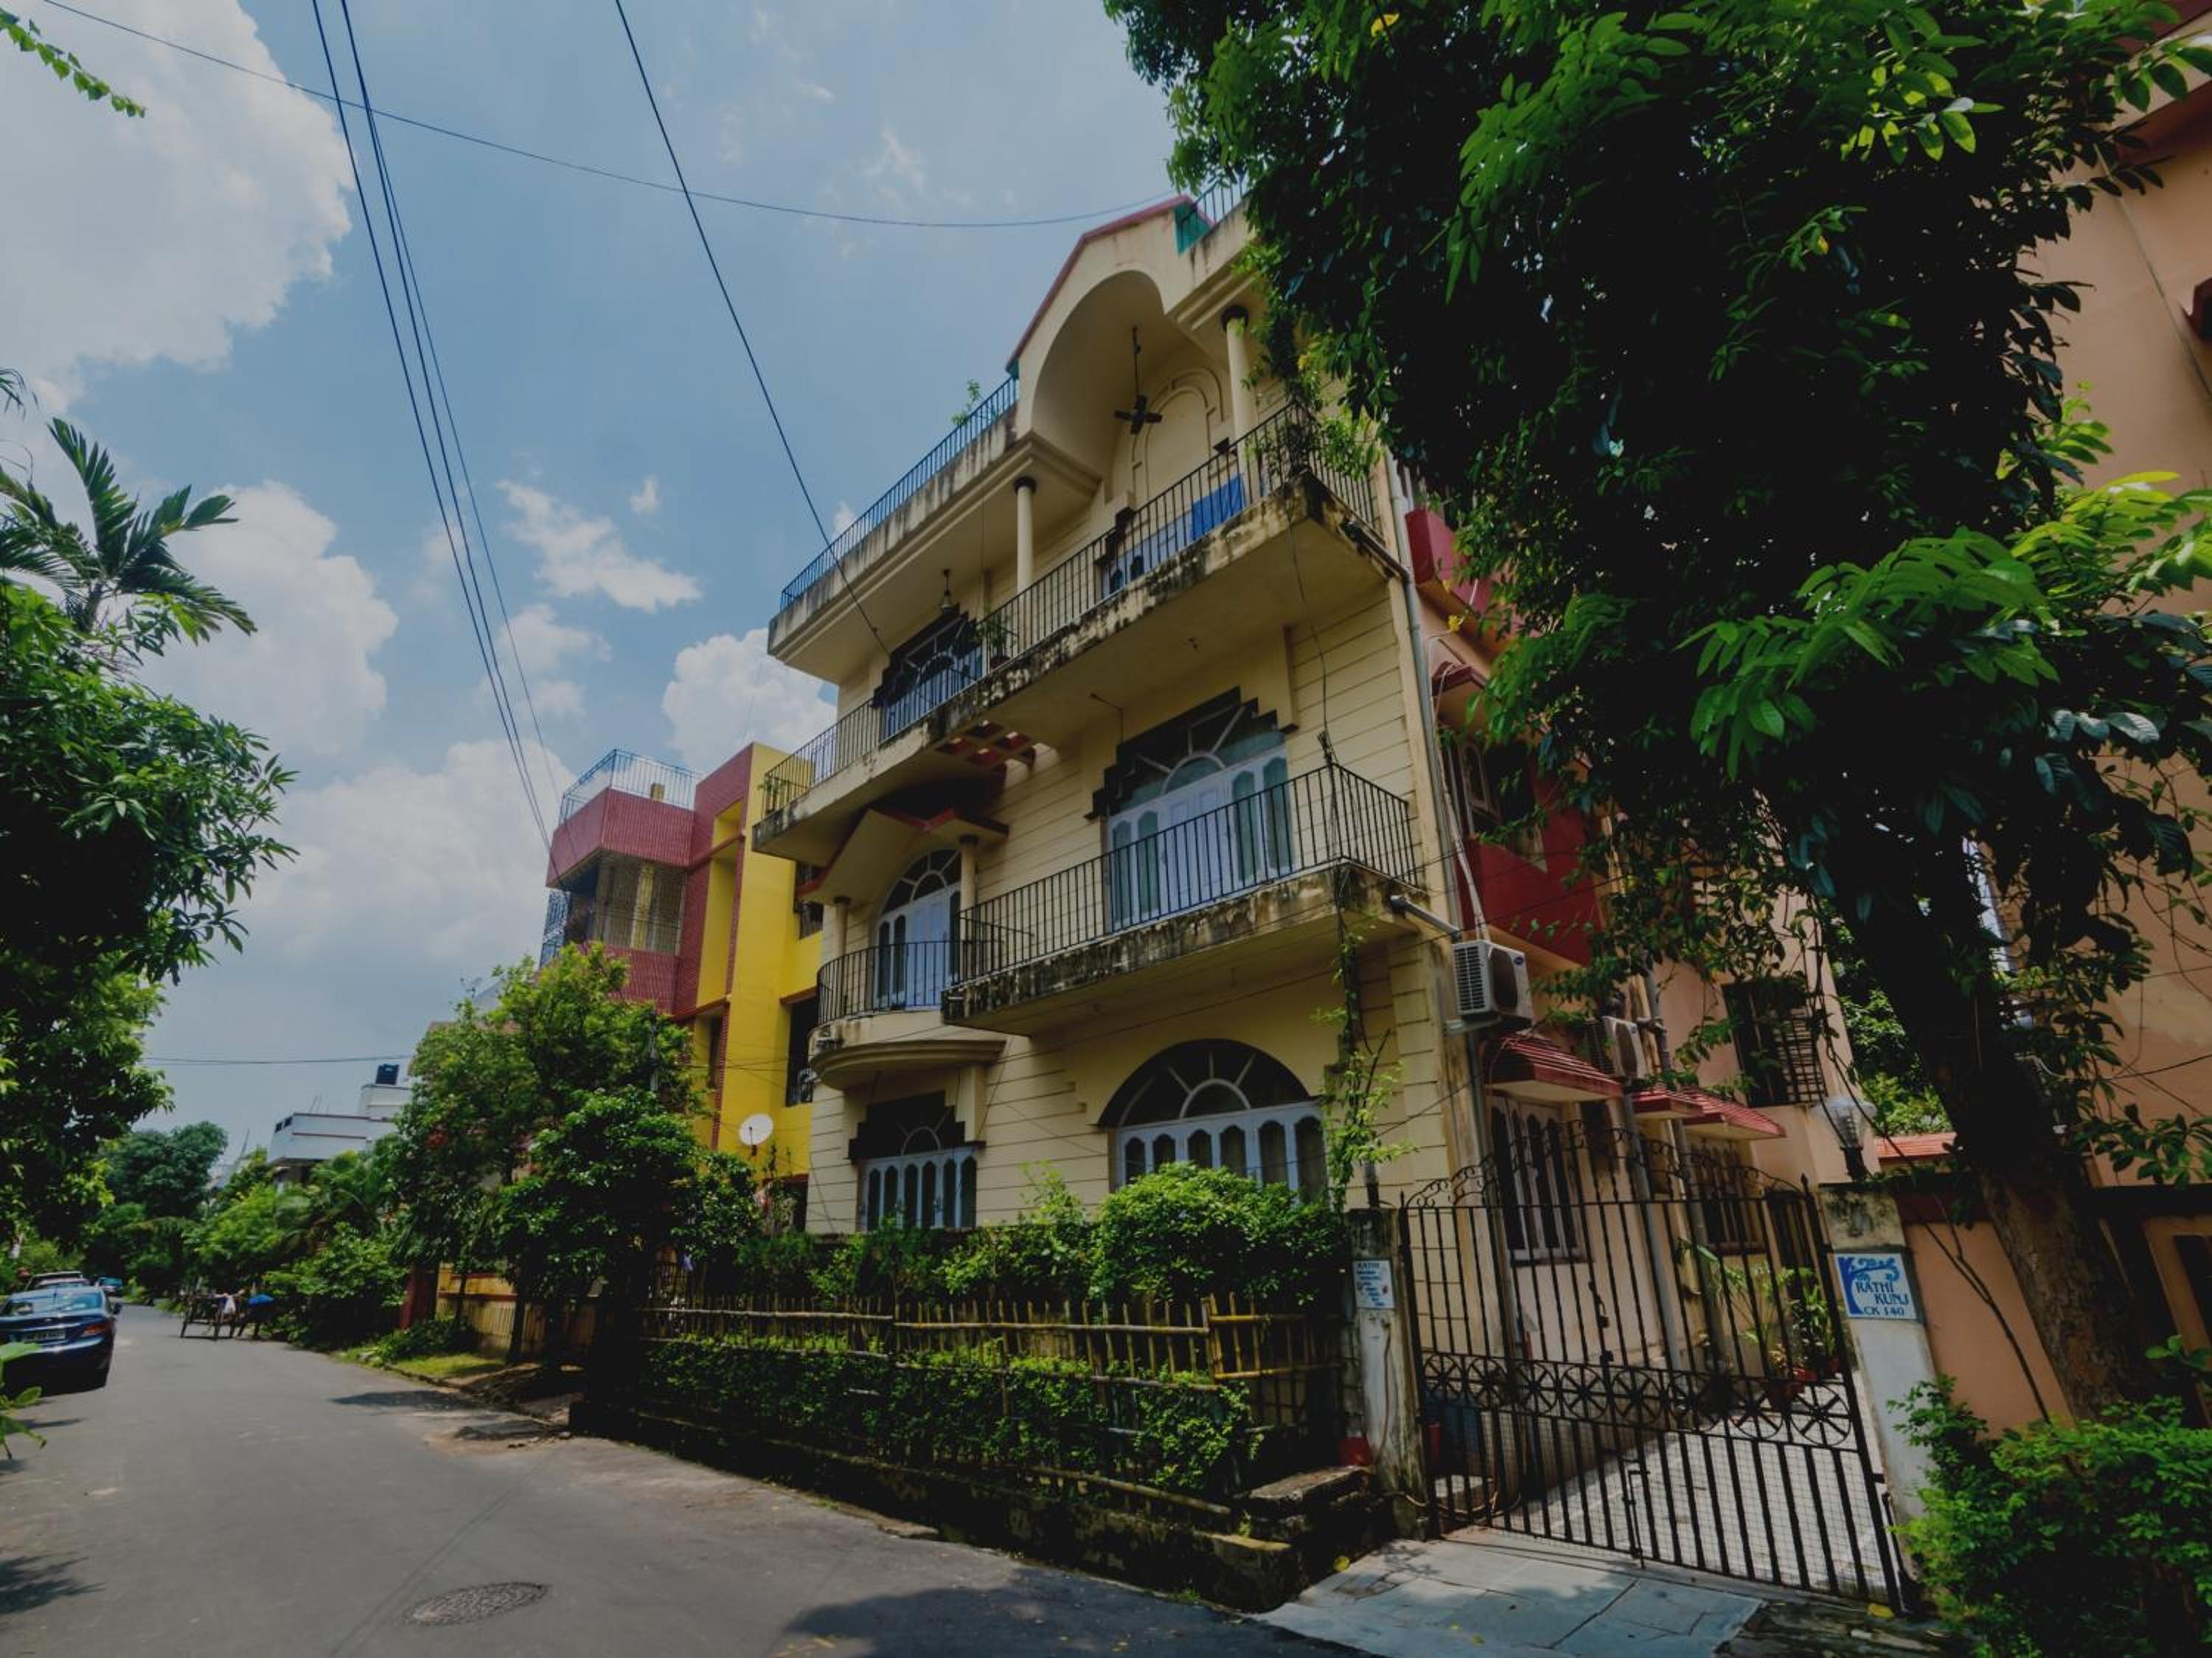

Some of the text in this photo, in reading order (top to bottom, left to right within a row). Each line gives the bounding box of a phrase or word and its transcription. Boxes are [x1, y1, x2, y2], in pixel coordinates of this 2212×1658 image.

[1855, 1281, 1894, 1293] RATHI
[1874, 1293, 1909, 1305] KUNJ
[1863, 1306, 1880, 1315] CK
